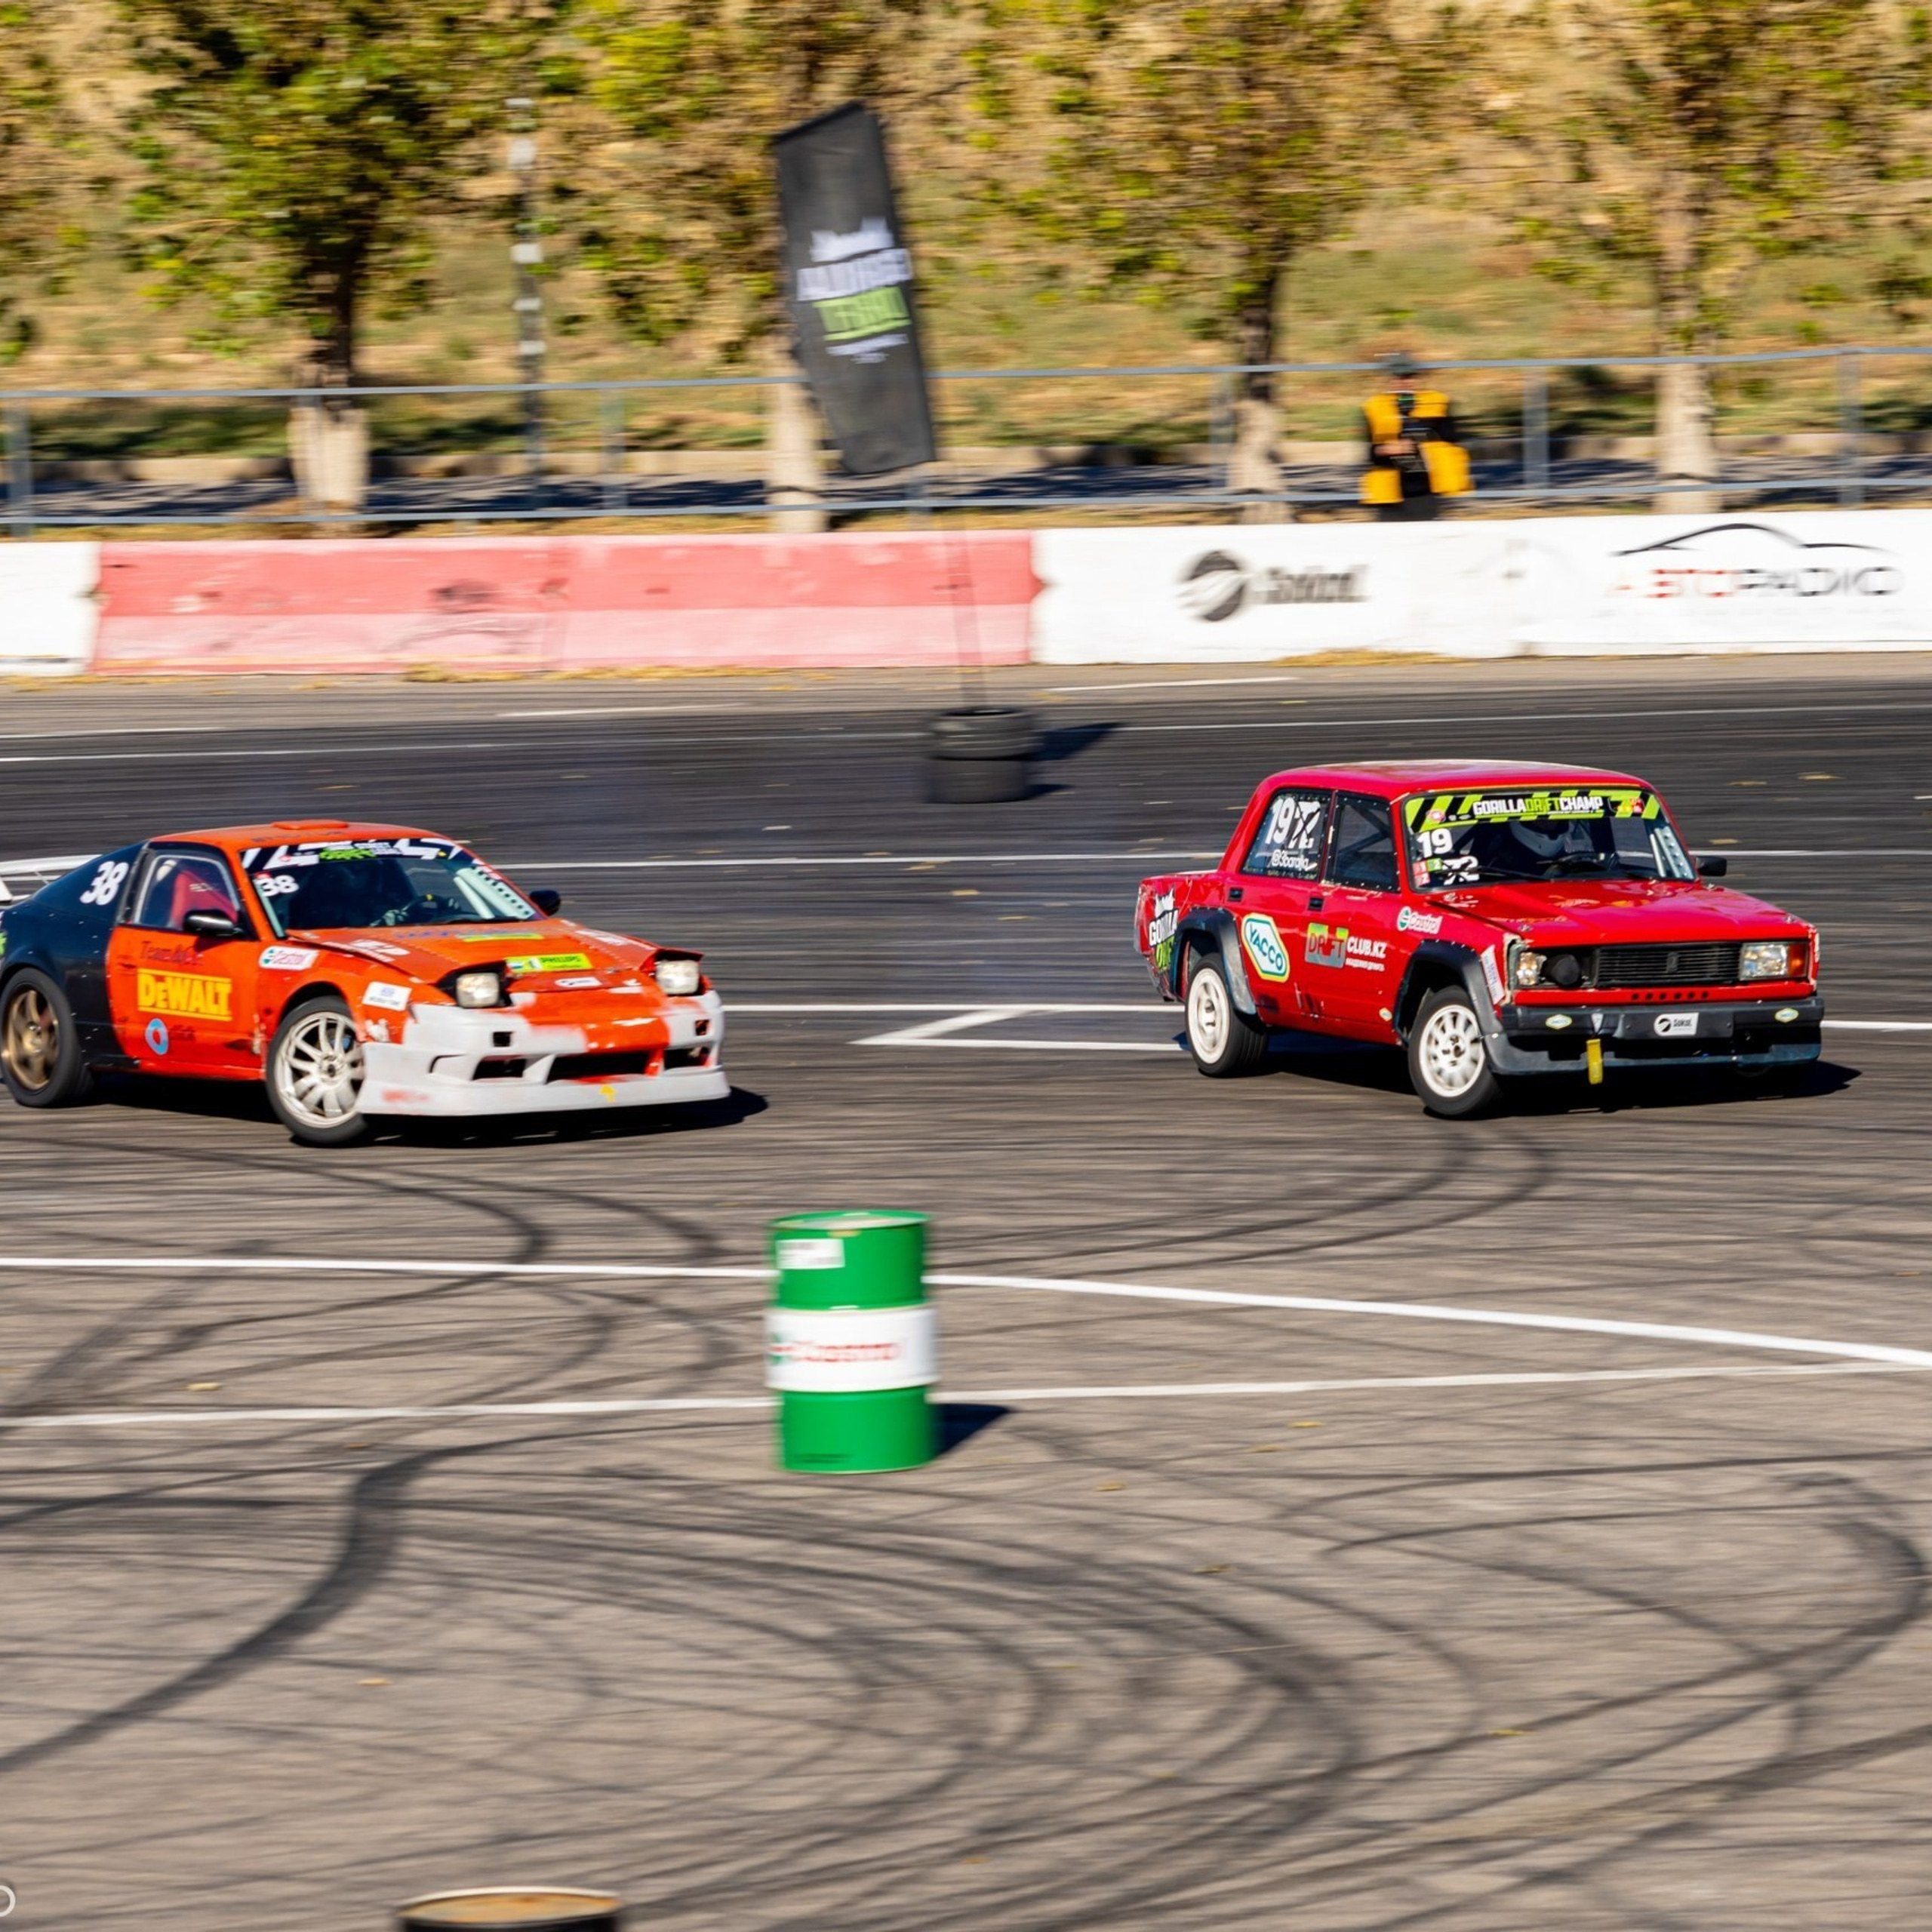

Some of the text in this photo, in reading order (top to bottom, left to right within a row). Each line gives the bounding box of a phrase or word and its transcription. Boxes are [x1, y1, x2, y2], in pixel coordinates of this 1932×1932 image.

[1265, 797, 1296, 844] 19
[1417, 828, 1453, 858] 19
[79, 860, 129, 906] 38
[257, 874, 300, 897] 38
[1249, 924, 1284, 971] YACCO
